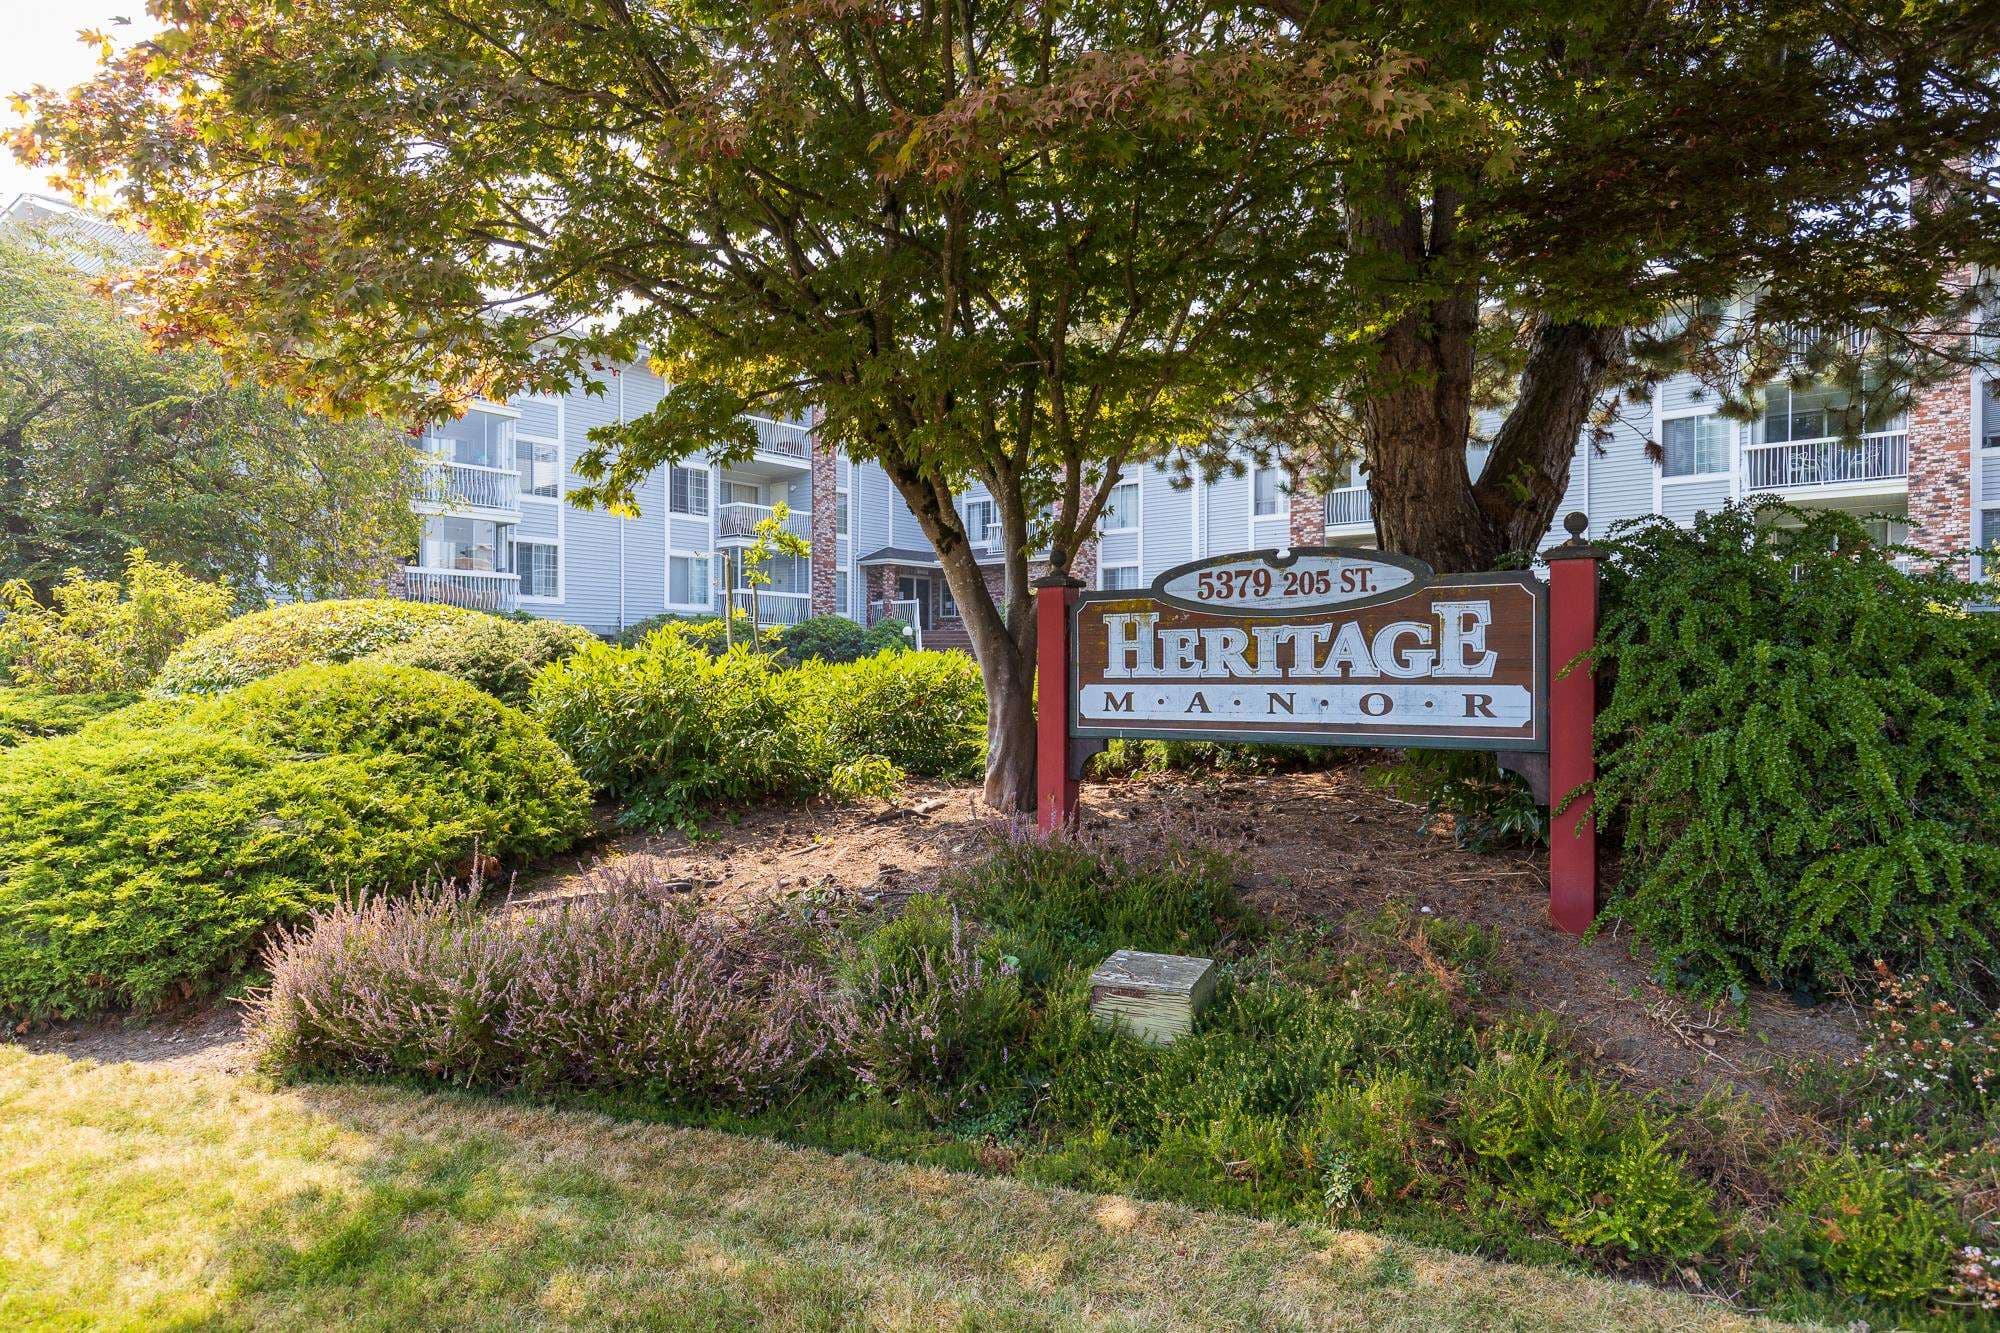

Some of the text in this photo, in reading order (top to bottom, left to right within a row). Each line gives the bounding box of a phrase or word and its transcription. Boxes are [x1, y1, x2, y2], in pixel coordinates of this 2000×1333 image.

[1197, 567, 1378, 600] 5379 205 ST.
[1102, 600, 1498, 679] HERITAGE
